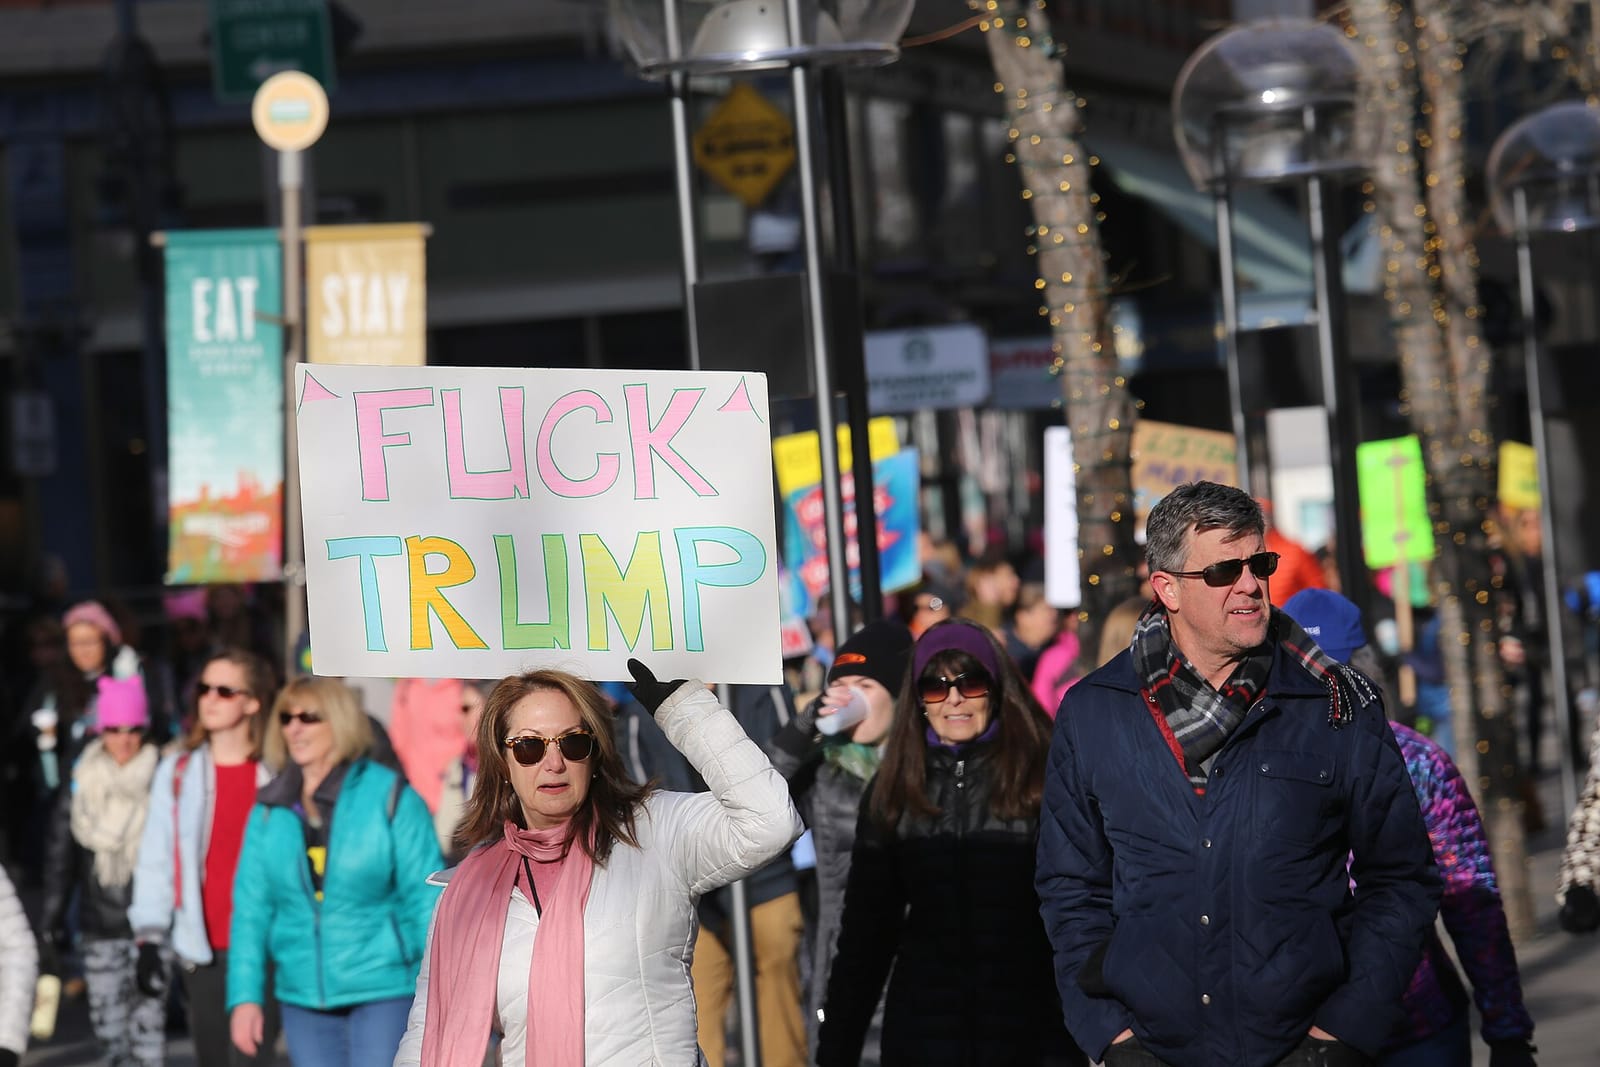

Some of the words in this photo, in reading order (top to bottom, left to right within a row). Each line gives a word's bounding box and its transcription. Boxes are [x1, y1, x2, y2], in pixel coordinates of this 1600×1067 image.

[192, 276, 259, 343] EAT
[321, 272, 410, 337] STAY
[354, 383, 719, 502] FUCK
[325, 526, 767, 653] TRUMP
